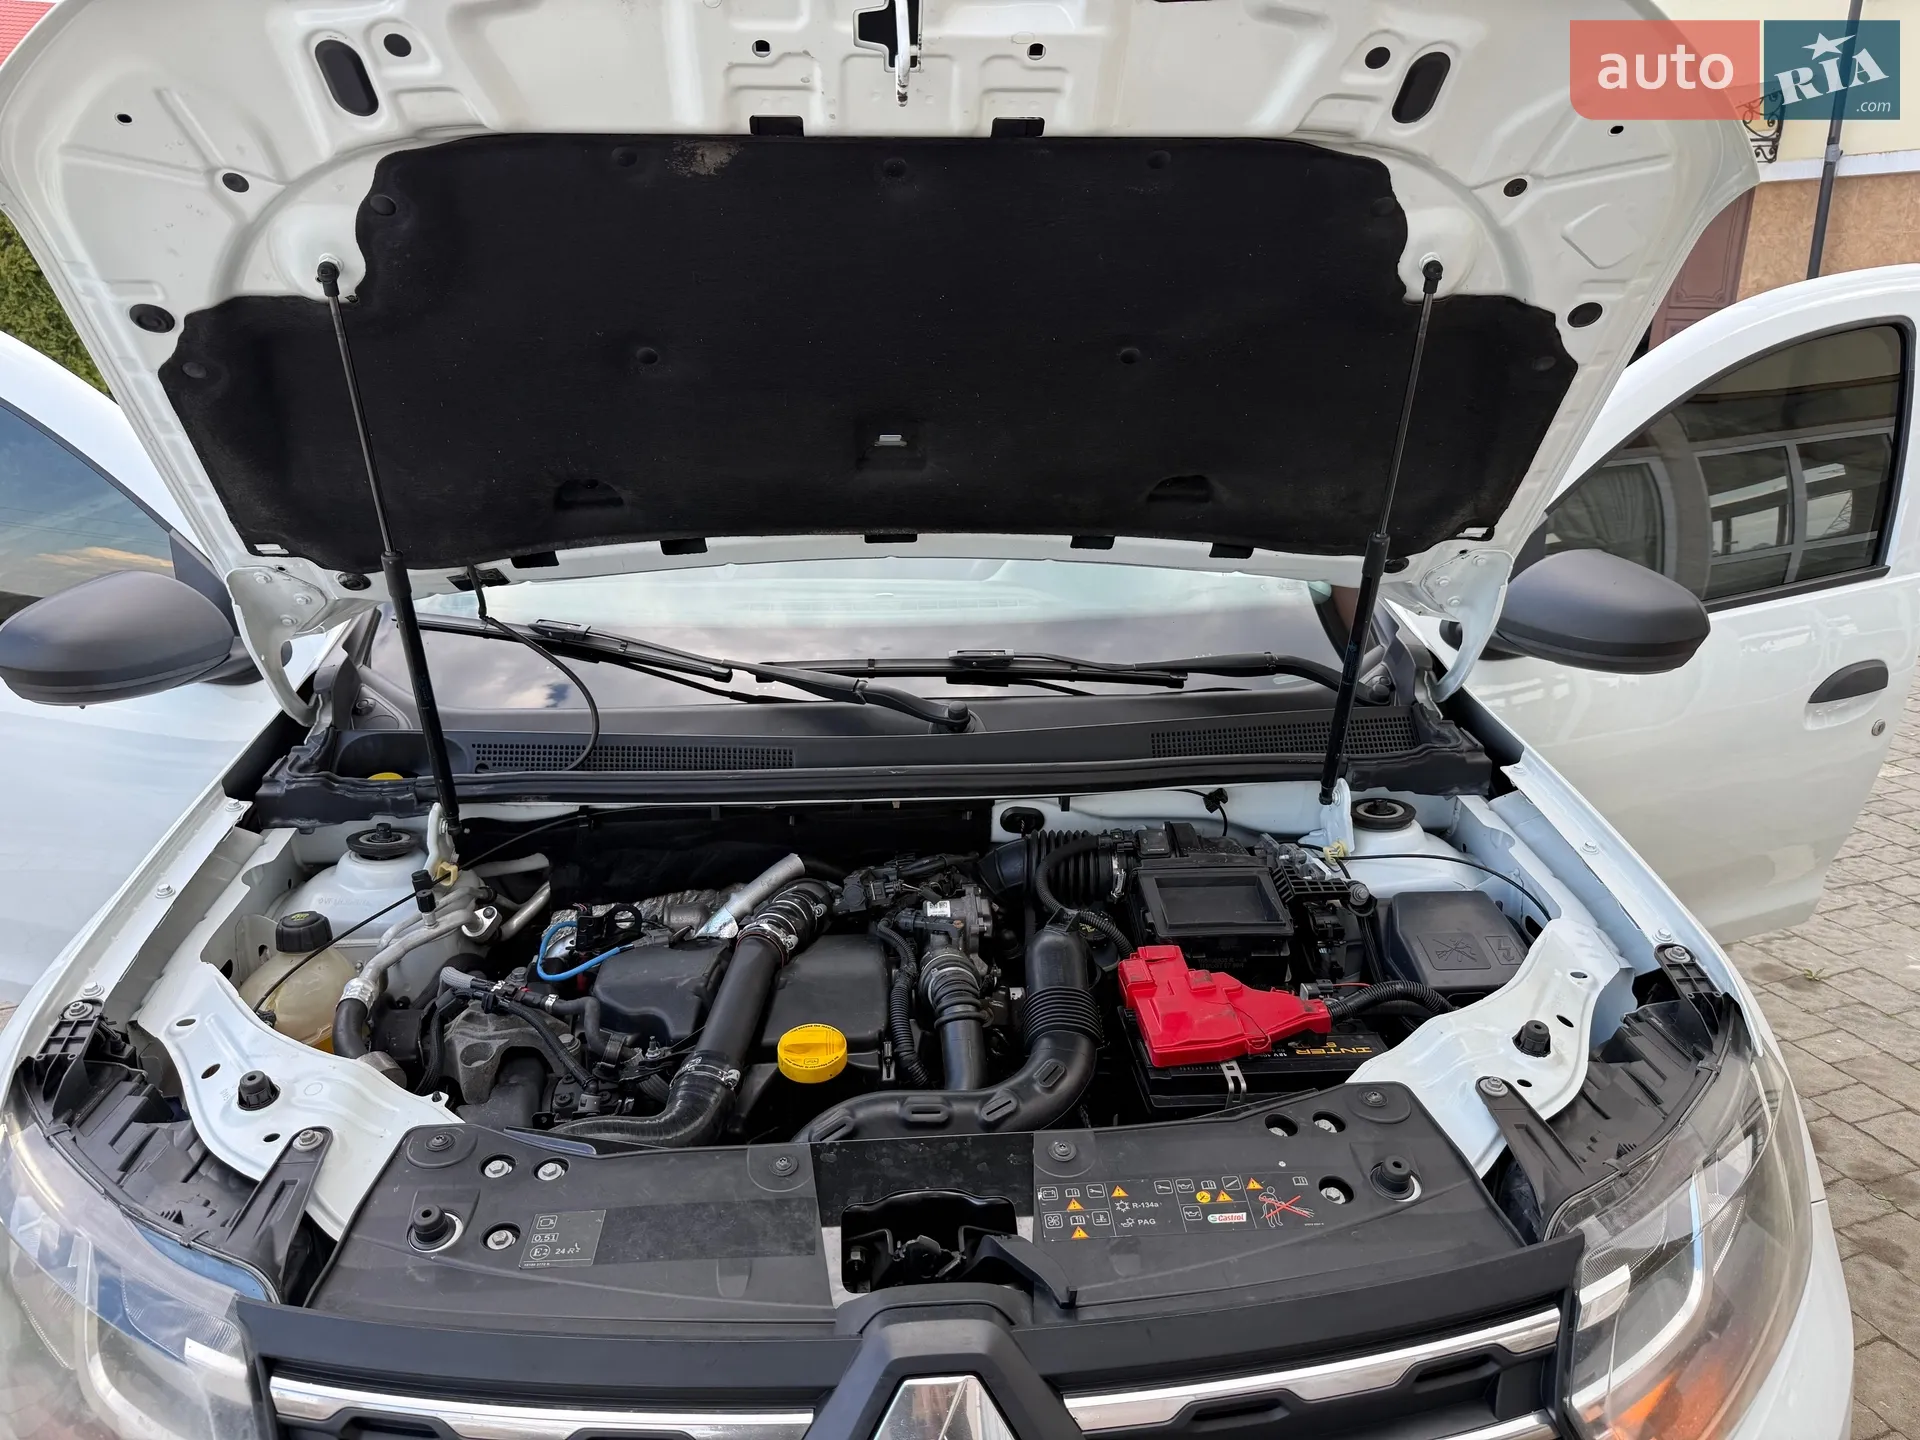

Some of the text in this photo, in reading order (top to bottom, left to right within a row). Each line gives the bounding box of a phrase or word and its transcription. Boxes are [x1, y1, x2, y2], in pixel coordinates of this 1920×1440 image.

[1295, 1047, 1373, 1055] INTER
[1217, 1213, 1245, 1222] Castrol
[1137, 1218, 1156, 1226] PAG
